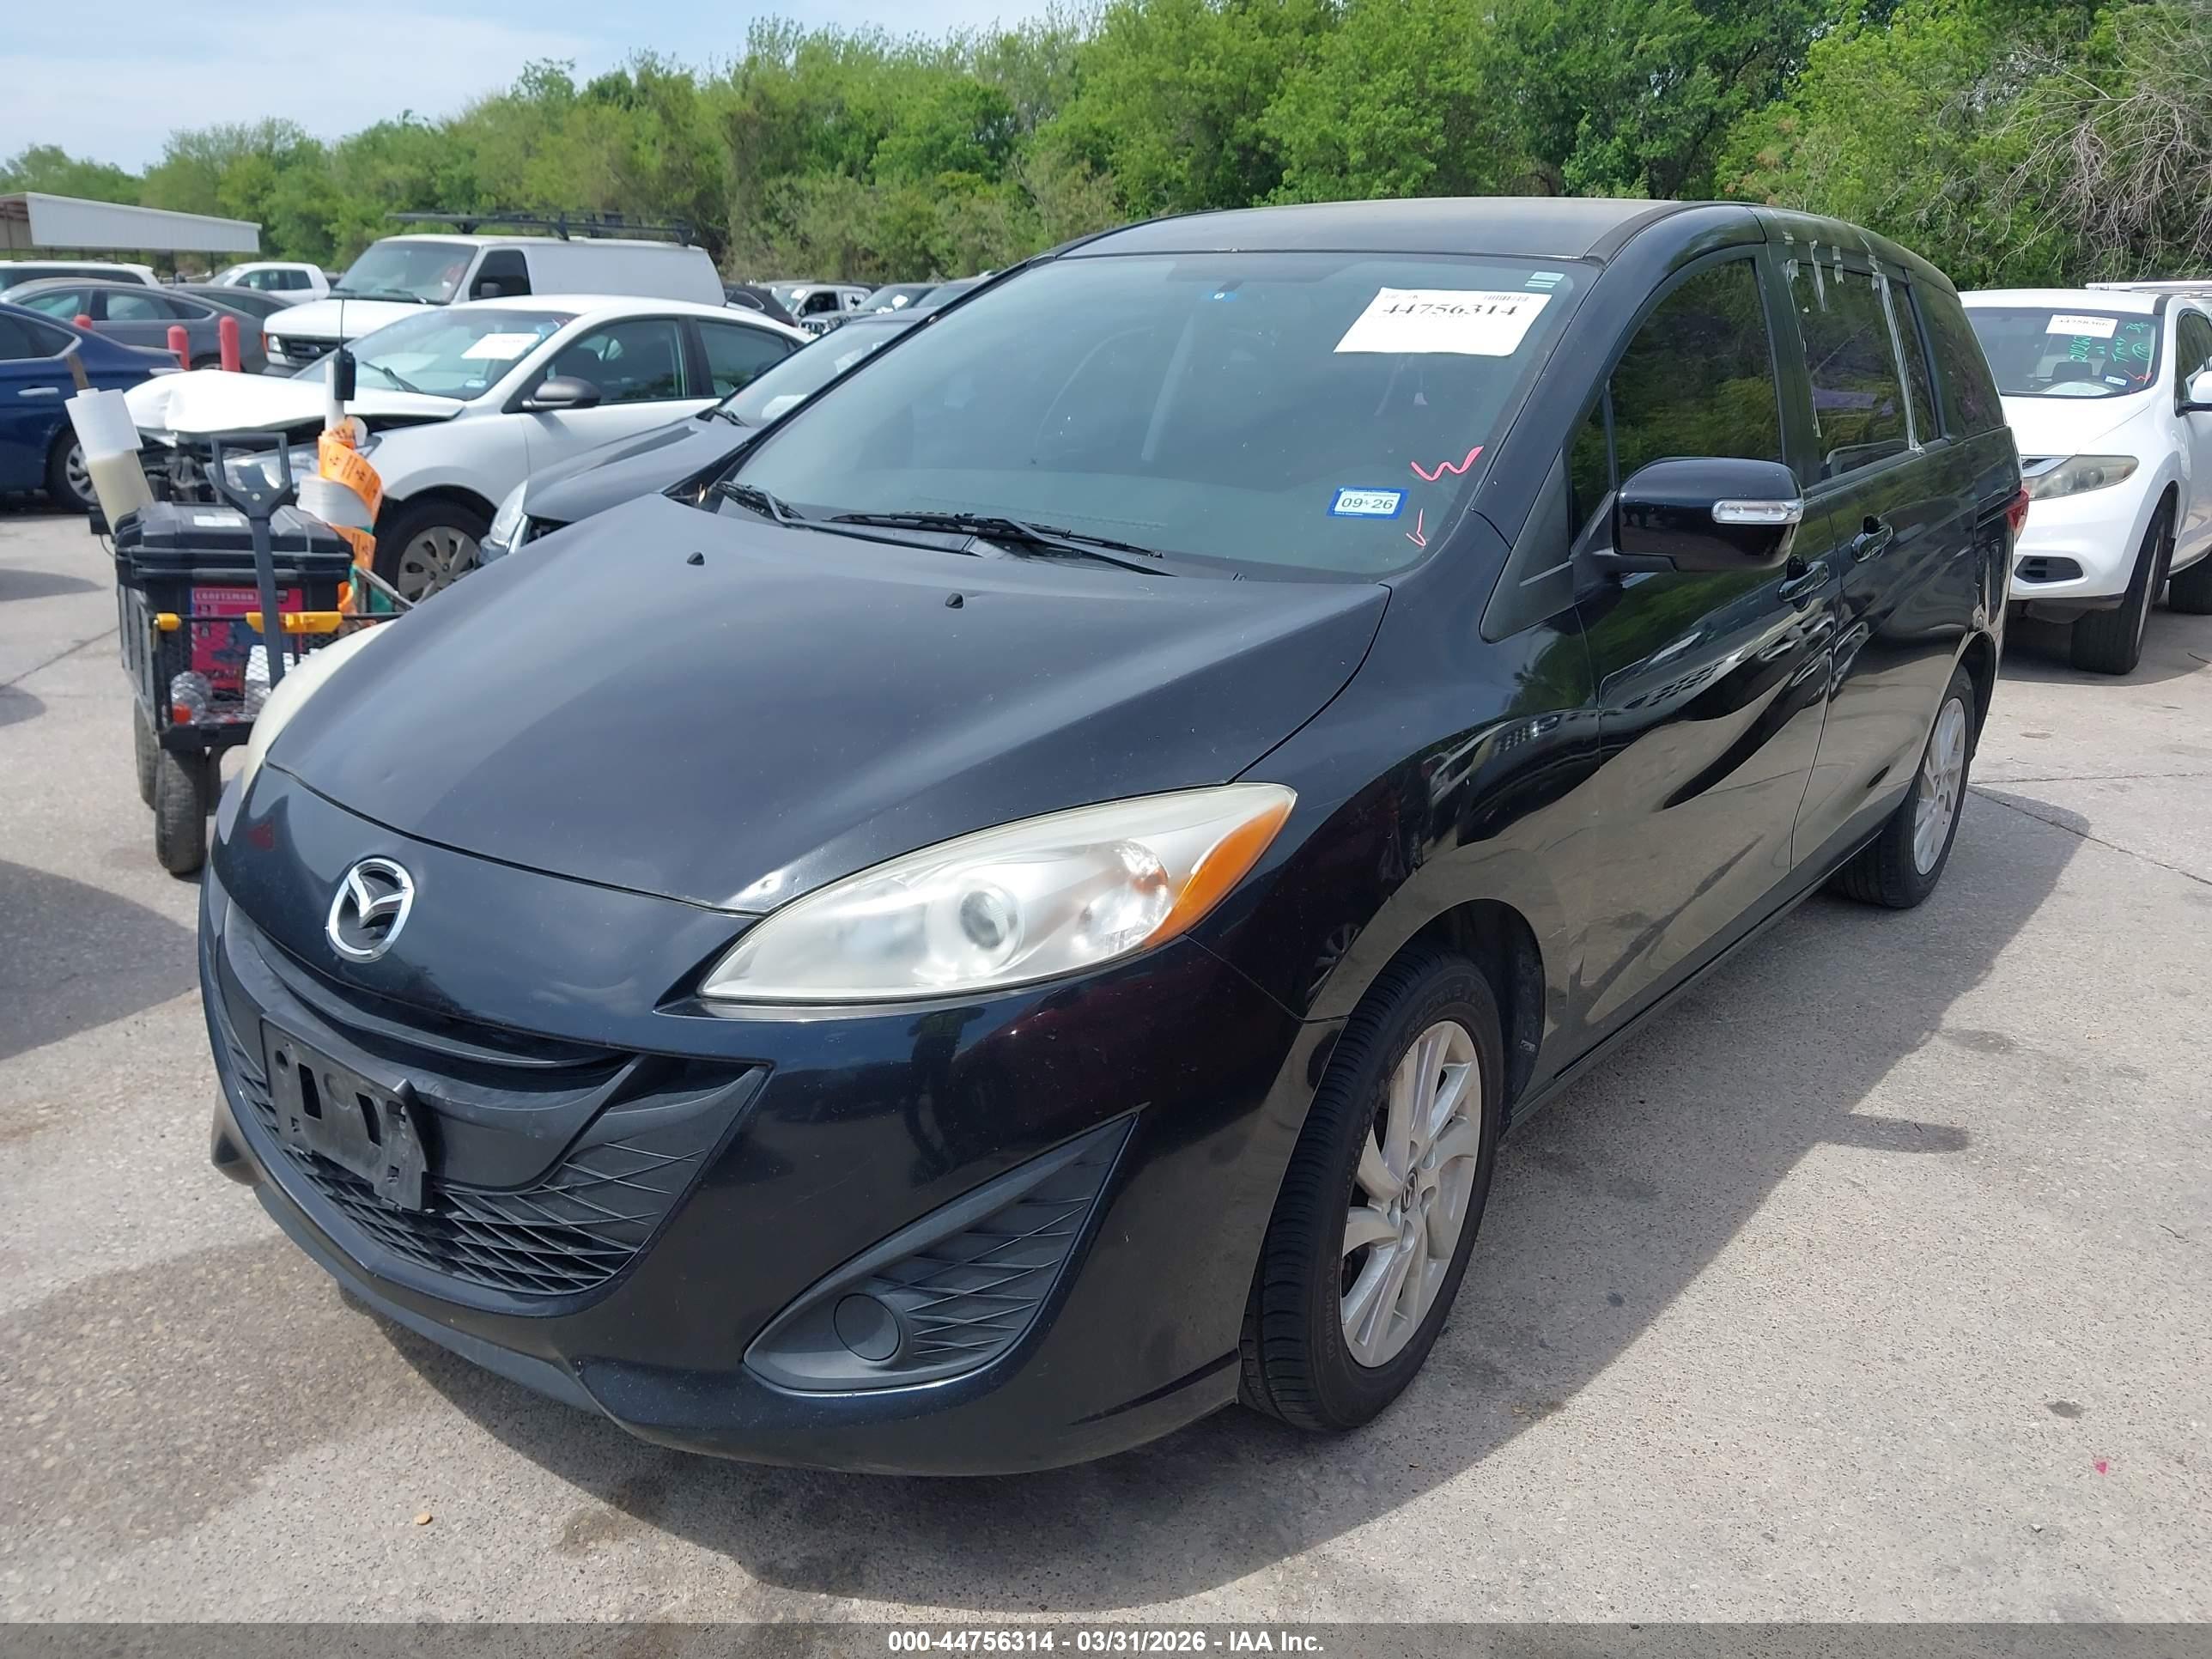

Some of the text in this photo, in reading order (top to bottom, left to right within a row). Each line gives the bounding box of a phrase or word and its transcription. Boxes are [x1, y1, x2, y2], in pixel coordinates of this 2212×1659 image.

[1382, 303, 1519, 316] 44756314
[1341, 497, 1395, 509] 09 26
